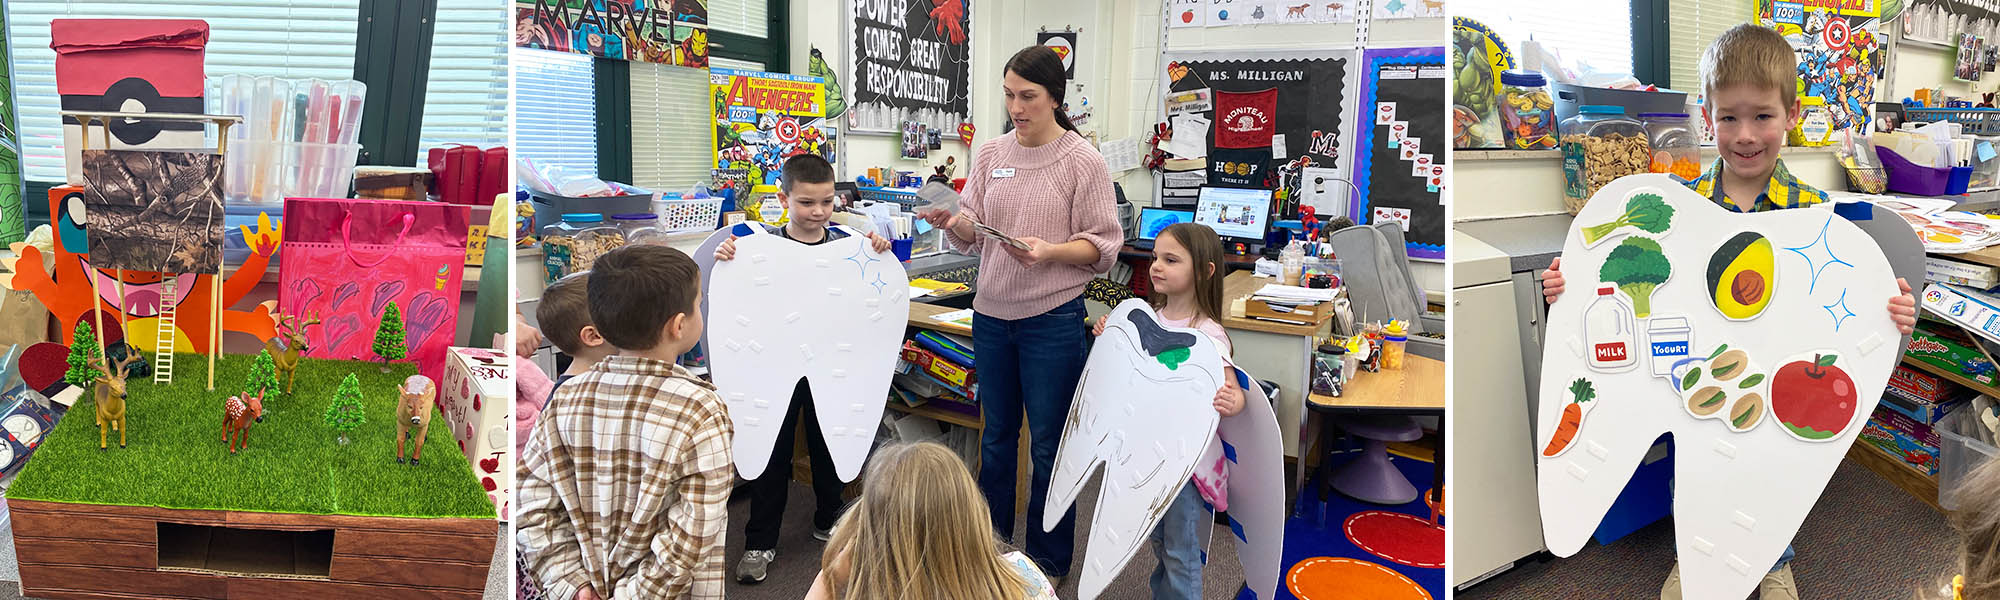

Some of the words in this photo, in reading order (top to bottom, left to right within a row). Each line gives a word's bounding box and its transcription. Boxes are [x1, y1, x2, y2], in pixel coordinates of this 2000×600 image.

[532, 0, 683, 45] MARVEL
[856, 0, 907, 30] POWER
[864, 26, 902, 62] COMES
[910, 37, 940, 70] GREAT
[1495, 52, 1504, 67] 2
[733, 70, 761, 78] MARVEL
[764, 72, 790, 80] COMICS
[866, 61, 950, 105] RESPONSIBILITY
[1209, 70, 1230, 81] MS.
[1237, 70, 1304, 81] MILLIGAN
[726, 75, 815, 116] AVENGERS
[1223, 106, 1268, 124] MONITEAU
[1598, 347, 1625, 358] MILK
